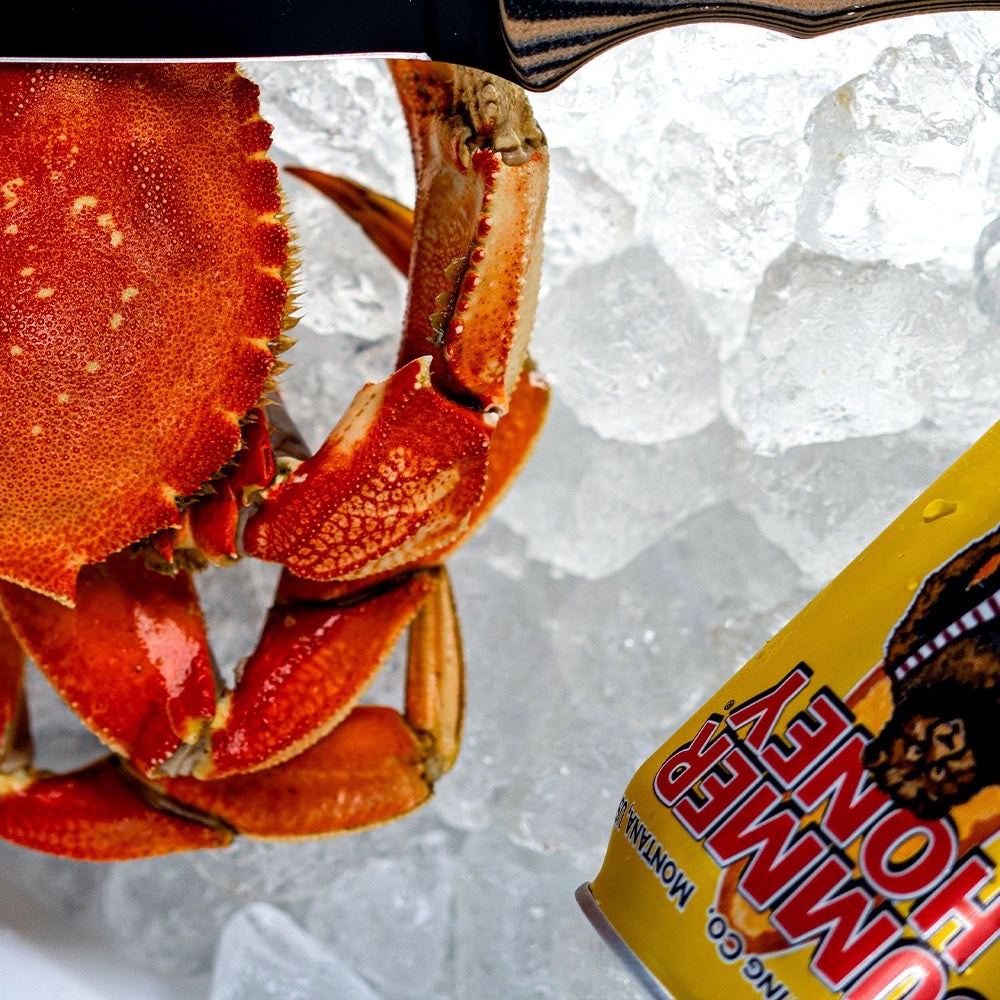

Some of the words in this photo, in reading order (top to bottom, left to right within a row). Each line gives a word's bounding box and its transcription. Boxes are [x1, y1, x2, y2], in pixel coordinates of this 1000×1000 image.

[622, 805, 696, 912] MONTANA,
[653, 716, 960, 1000] UMMER
[727, 663, 1000, 973] HONEY
[706, 906, 744, 963] CO.
